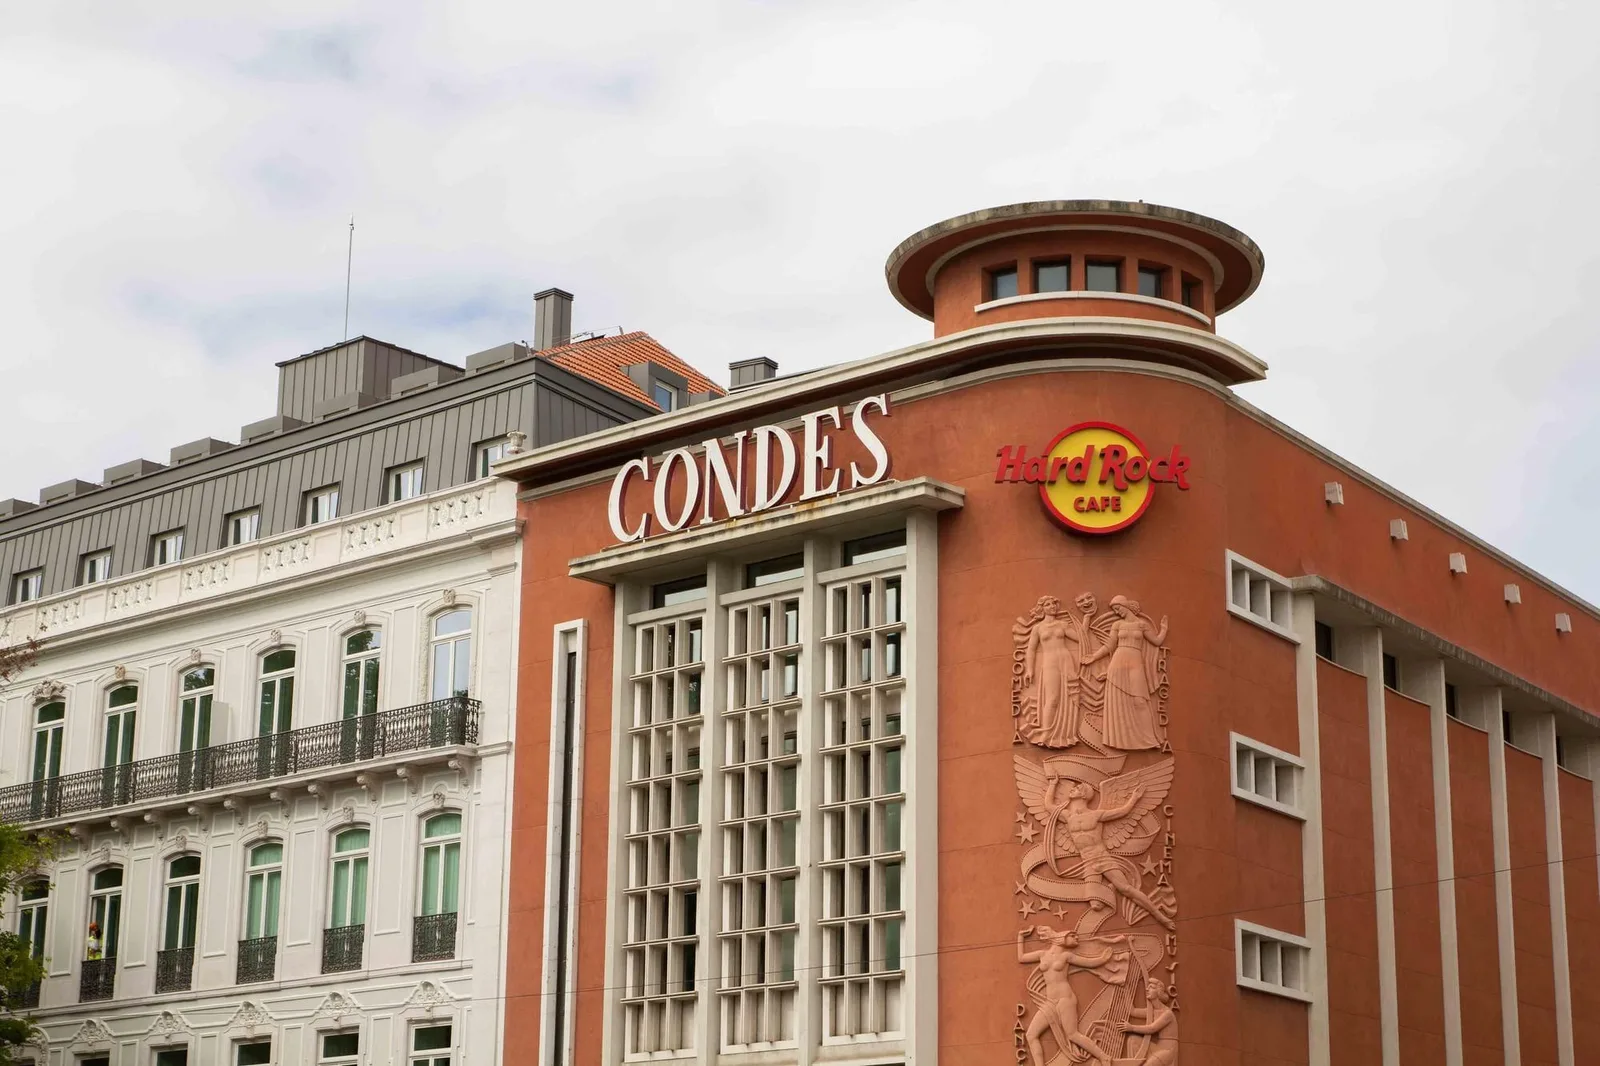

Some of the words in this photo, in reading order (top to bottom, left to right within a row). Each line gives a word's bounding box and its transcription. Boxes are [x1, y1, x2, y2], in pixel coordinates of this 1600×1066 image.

[608, 393, 891, 543] CONDES
[995, 445, 1095, 484] Hard
[1098, 444, 1191, 491] Rock
[1074, 496, 1121, 512] CAFE
[1012, 649, 1025, 744] COMEDIA
[1157, 646, 1173, 754] TRAGEDIA
[1157, 804, 1176, 886] CINEMA
[1013, 1003, 1027, 1066] DANÇ
